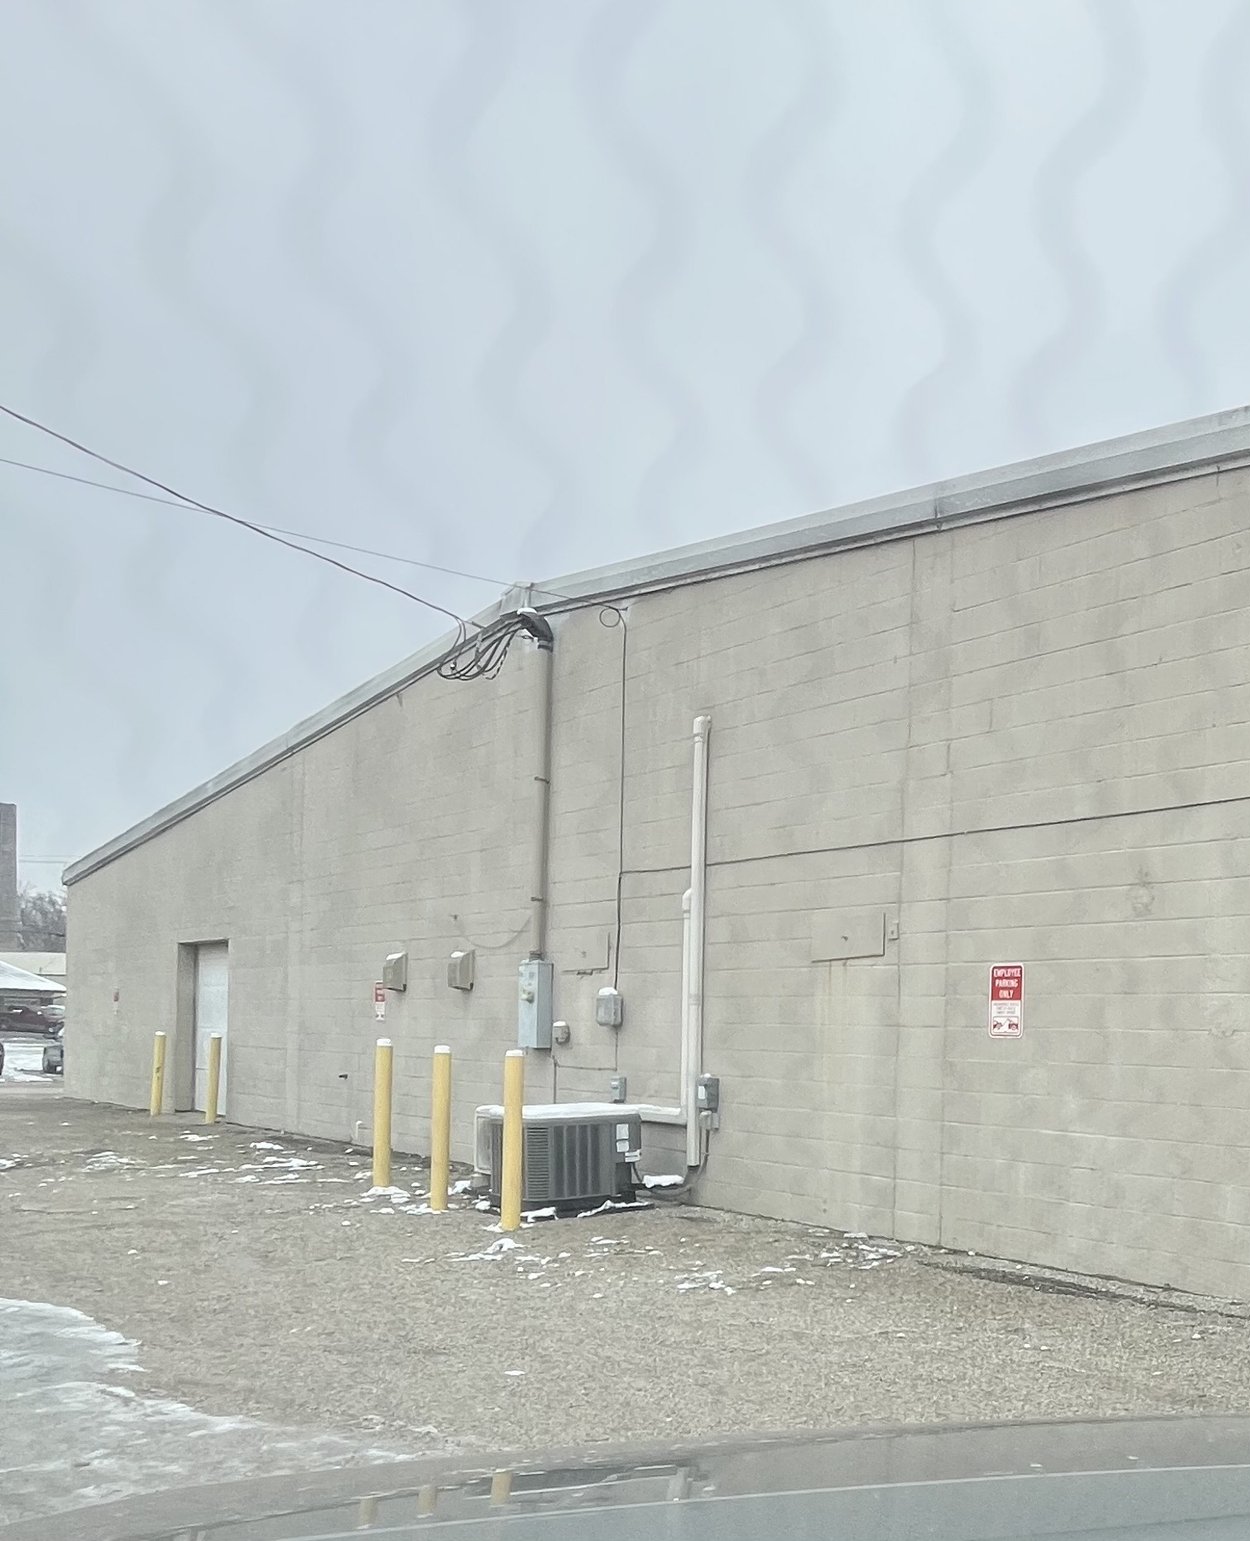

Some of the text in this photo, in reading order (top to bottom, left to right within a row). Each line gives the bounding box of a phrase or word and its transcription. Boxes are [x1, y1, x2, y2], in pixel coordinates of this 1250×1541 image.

[993, 967, 1021, 978] EMPLOYEE
[995, 979, 1019, 988] PARKING
[998, 989, 1014, 999] ONLY
